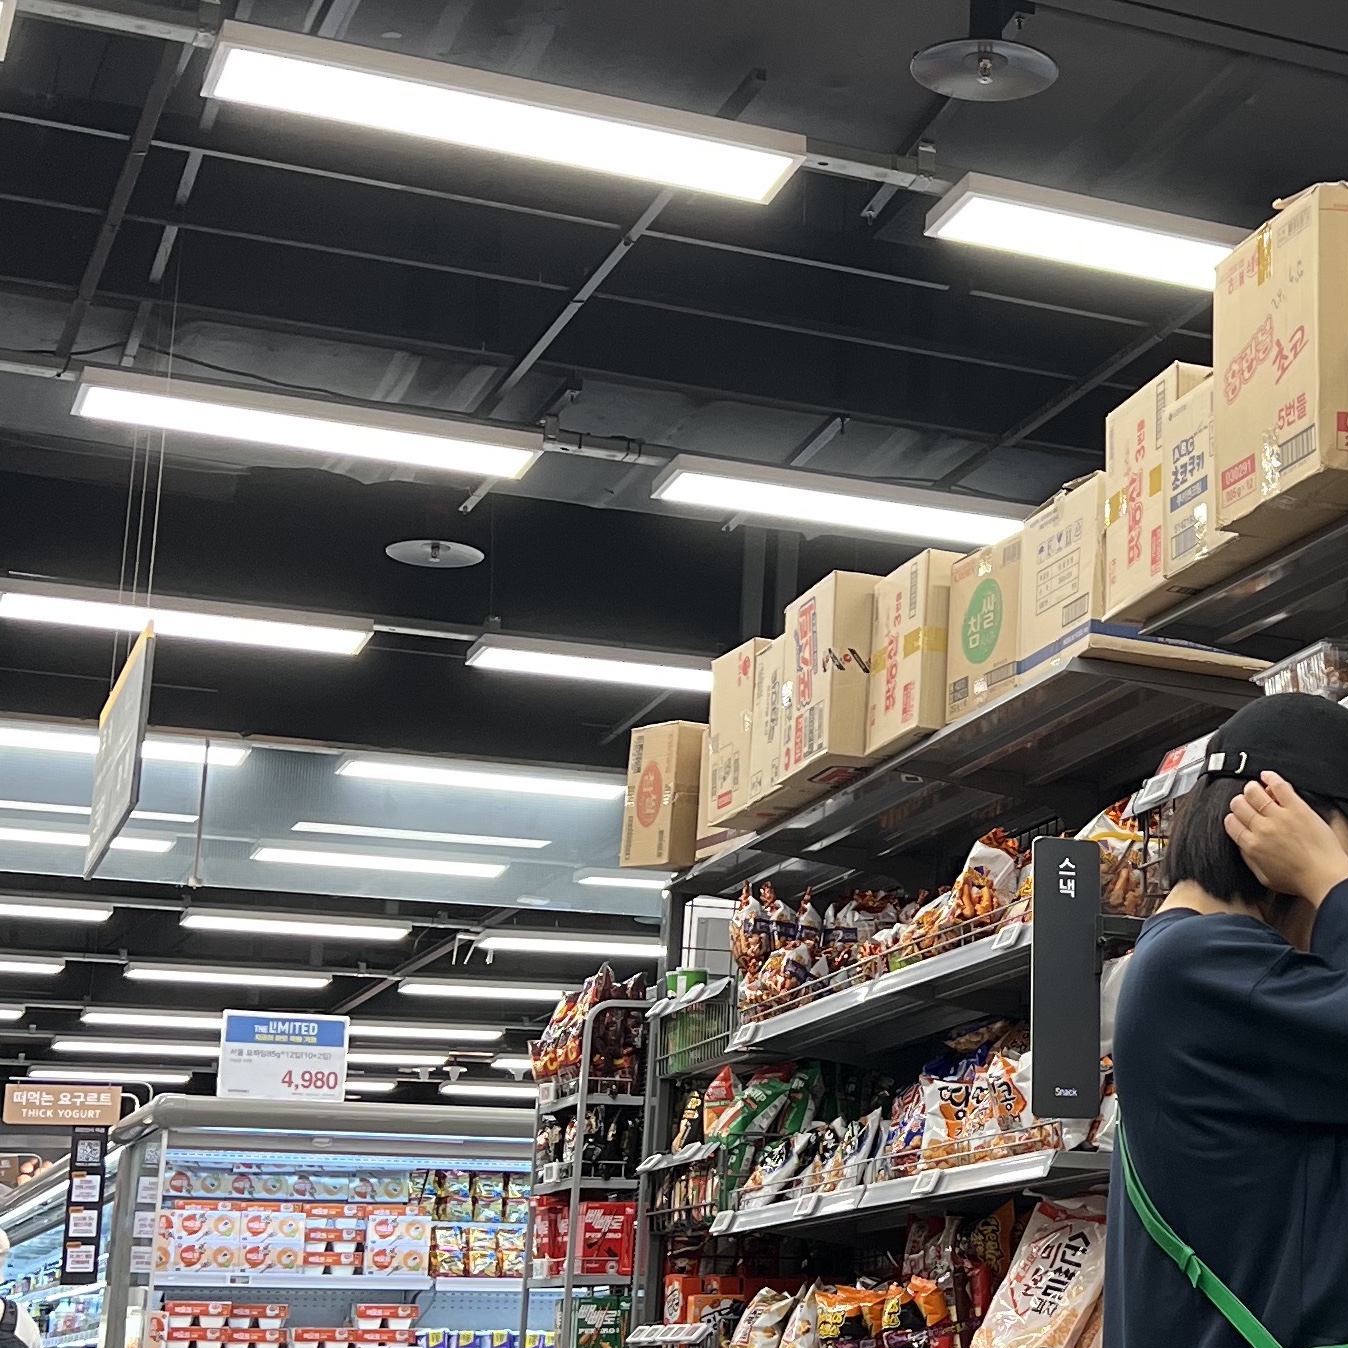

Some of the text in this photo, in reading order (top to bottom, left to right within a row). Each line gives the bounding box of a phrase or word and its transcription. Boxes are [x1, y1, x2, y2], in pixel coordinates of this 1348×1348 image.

[1272, 325, 1309, 385] 초코
[1278, 393, 1307, 430] 5번들
[1172, 437, 1195, 464] ABC
[1172, 452, 1205, 492] 초코쿠키
[1058, 857, 1076, 898] 스낵
[269, 1021, 318, 1036] LIMITED
[281, 1069, 338, 1091] 4,980
[1055, 1087, 1078, 1097] Snack
[13, 1090, 112, 1107] 떠먹는 요구르트
[22, 1108, 101, 1118] THICK YOGURT
[584, 1208, 624, 1232] 빼빼로
[578, 1303, 618, 1327] 빼빼로
